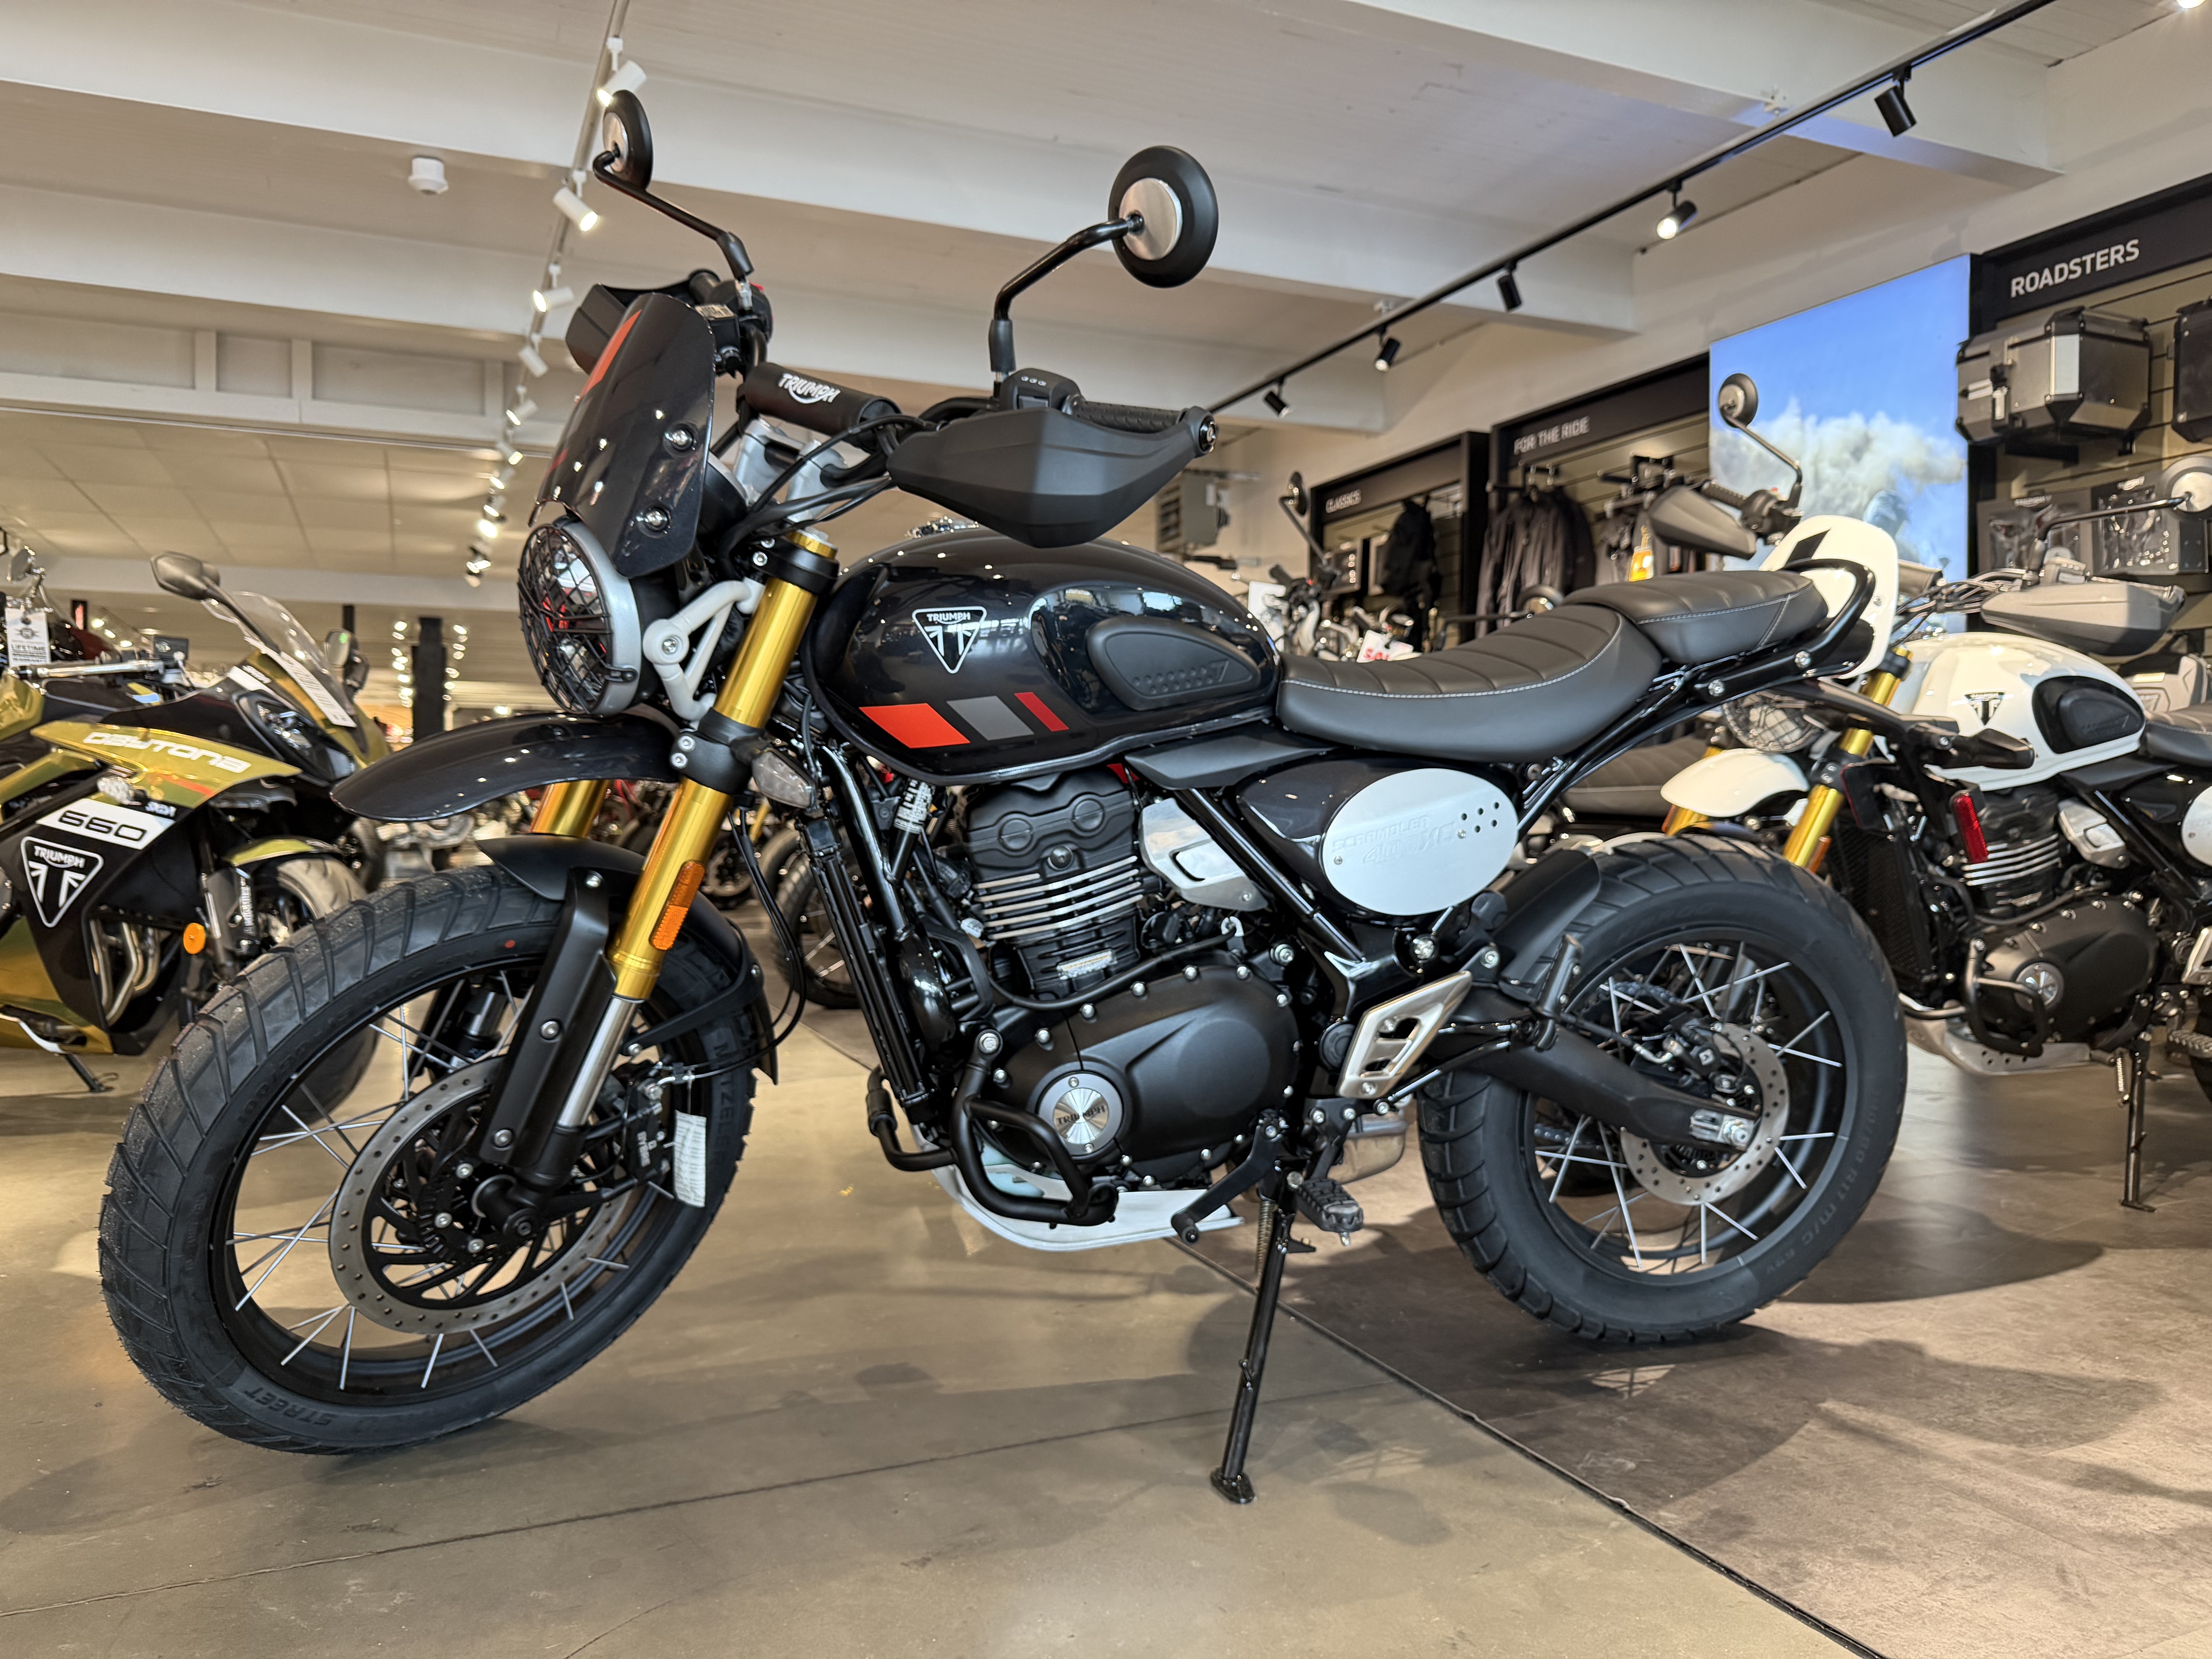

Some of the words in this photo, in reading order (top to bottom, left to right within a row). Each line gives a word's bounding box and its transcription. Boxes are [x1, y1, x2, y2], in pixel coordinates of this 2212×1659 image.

[2011, 239, 2140, 298] ROADSTERS
[778, 373, 841, 404] TRIUMPH
[1514, 433, 1537, 455] FOR
[1537, 425, 1561, 447] THE
[1561, 416, 1590, 440] RIDE
[926, 612, 971, 624] TRIUMPH
[83, 732, 252, 773] DAYTONA
[58, 810, 148, 842] 660
[1332, 814, 1429, 852] SCRAMBLER
[34, 845, 86, 868] TRIUMPH
[1056, 1105, 1106, 1125] TRIUMPH
[245, 1388, 336, 1426] STREET
